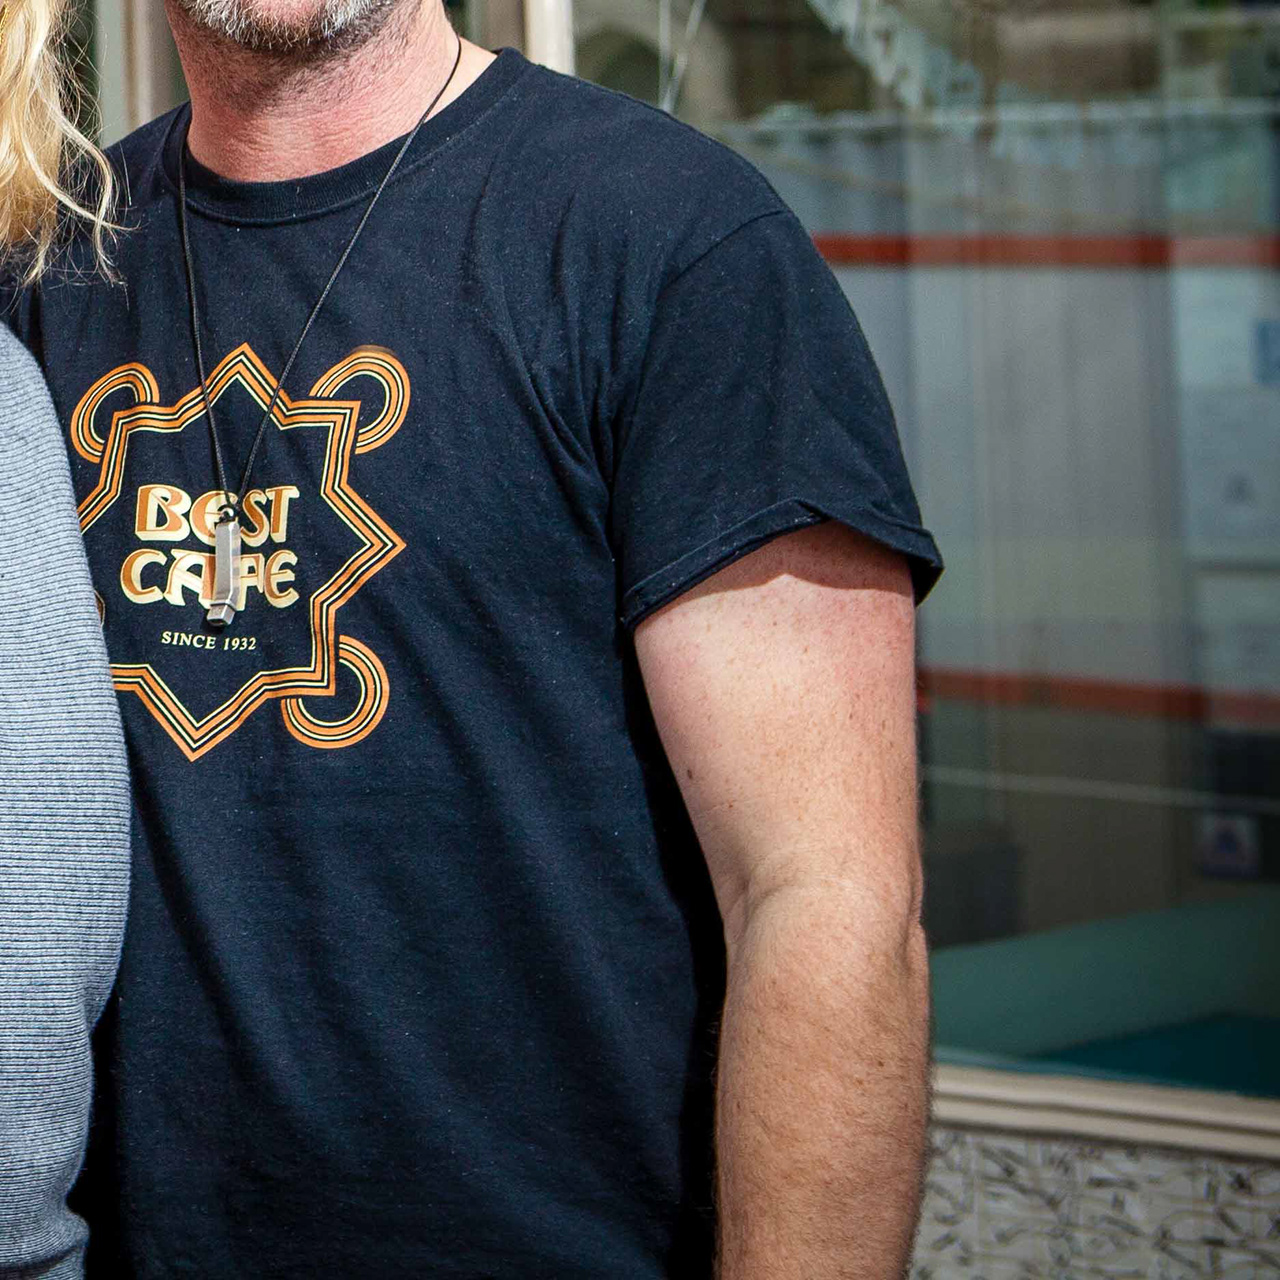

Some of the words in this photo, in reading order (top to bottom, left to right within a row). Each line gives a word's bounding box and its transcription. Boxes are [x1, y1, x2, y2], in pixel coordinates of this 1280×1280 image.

[135, 484, 300, 547] BEST
[161, 631, 216, 649] SINCE
[223, 637, 257, 650] 1932
